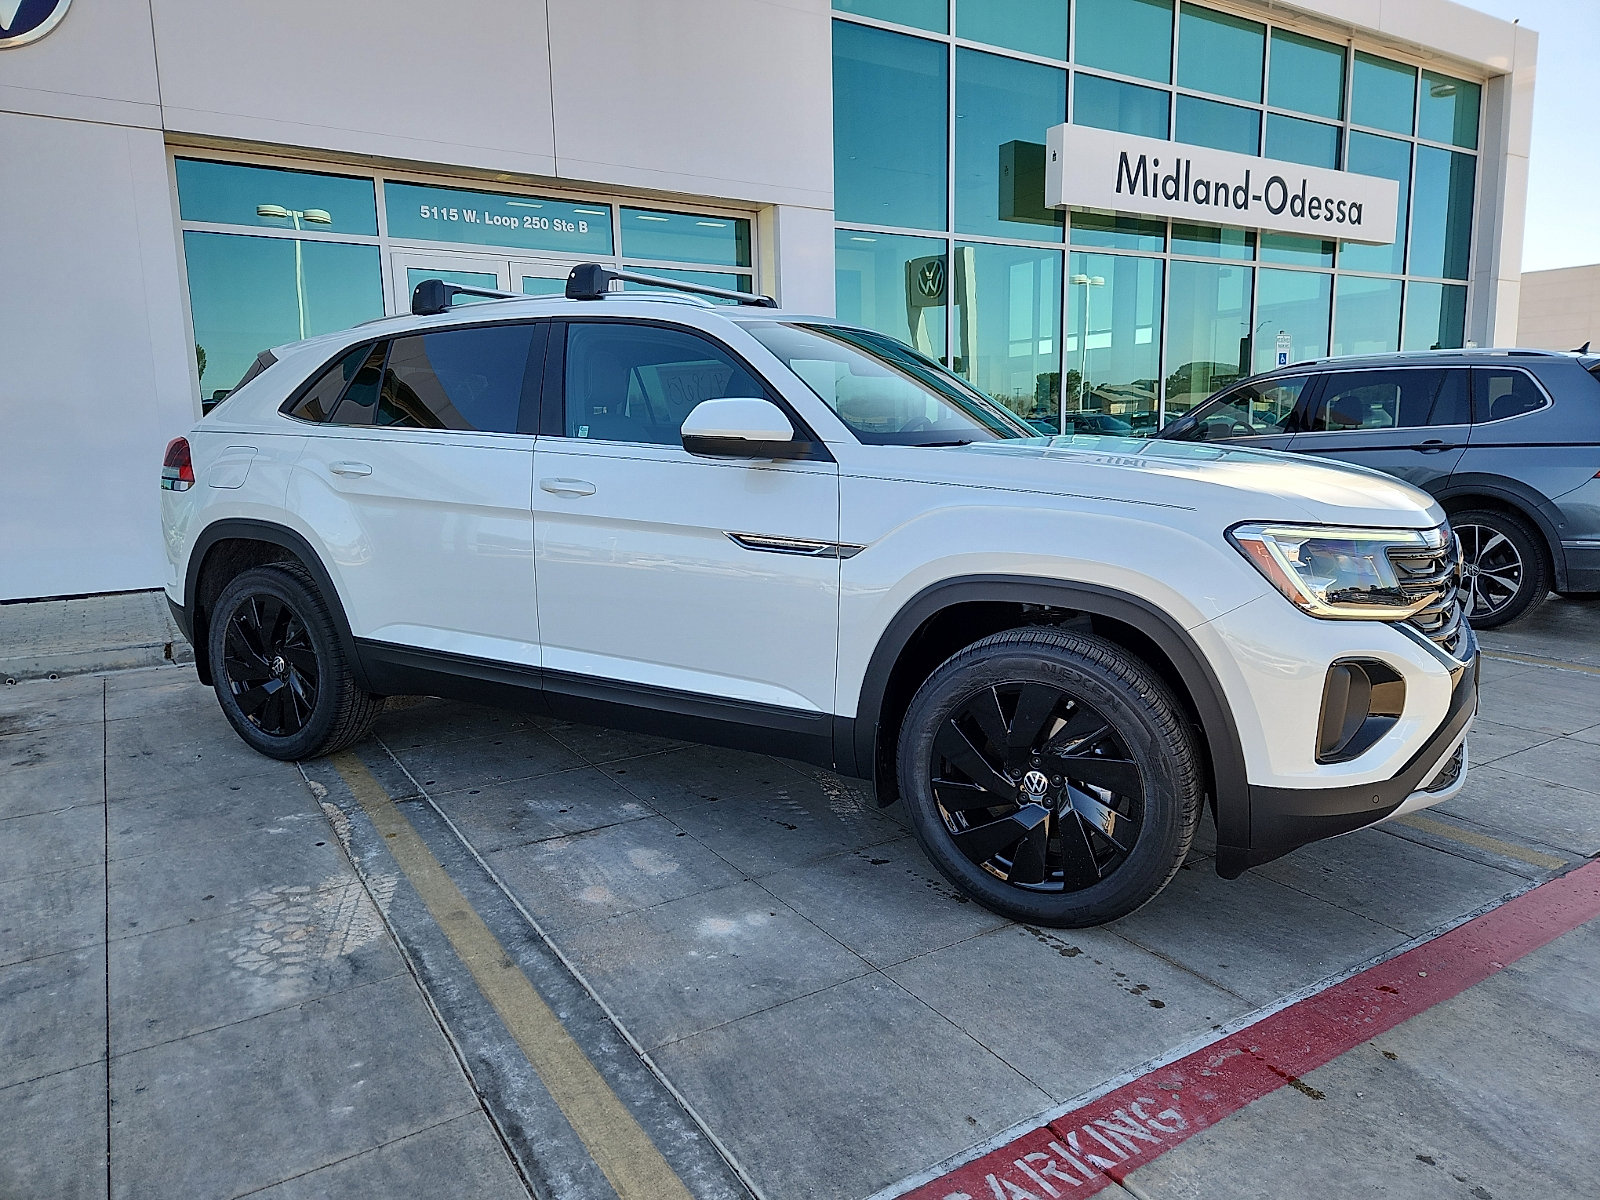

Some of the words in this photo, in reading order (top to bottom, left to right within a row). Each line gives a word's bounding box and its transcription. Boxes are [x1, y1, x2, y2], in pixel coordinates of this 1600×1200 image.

[1115, 150, 1363, 226] Midland-Odessa
[420, 205, 459, 221] 5115
[462, 209, 480, 224] W.
[485, 211, 519, 230] Loop
[523, 215, 549, 230] 250
[553, 218, 575, 232] Ste
[578, 220, 589, 233] B
[1041, 661, 1123, 712] NEXEN
[1024, 771, 1048, 795] VW
[942, 1096, 1190, 1200] ARKING
